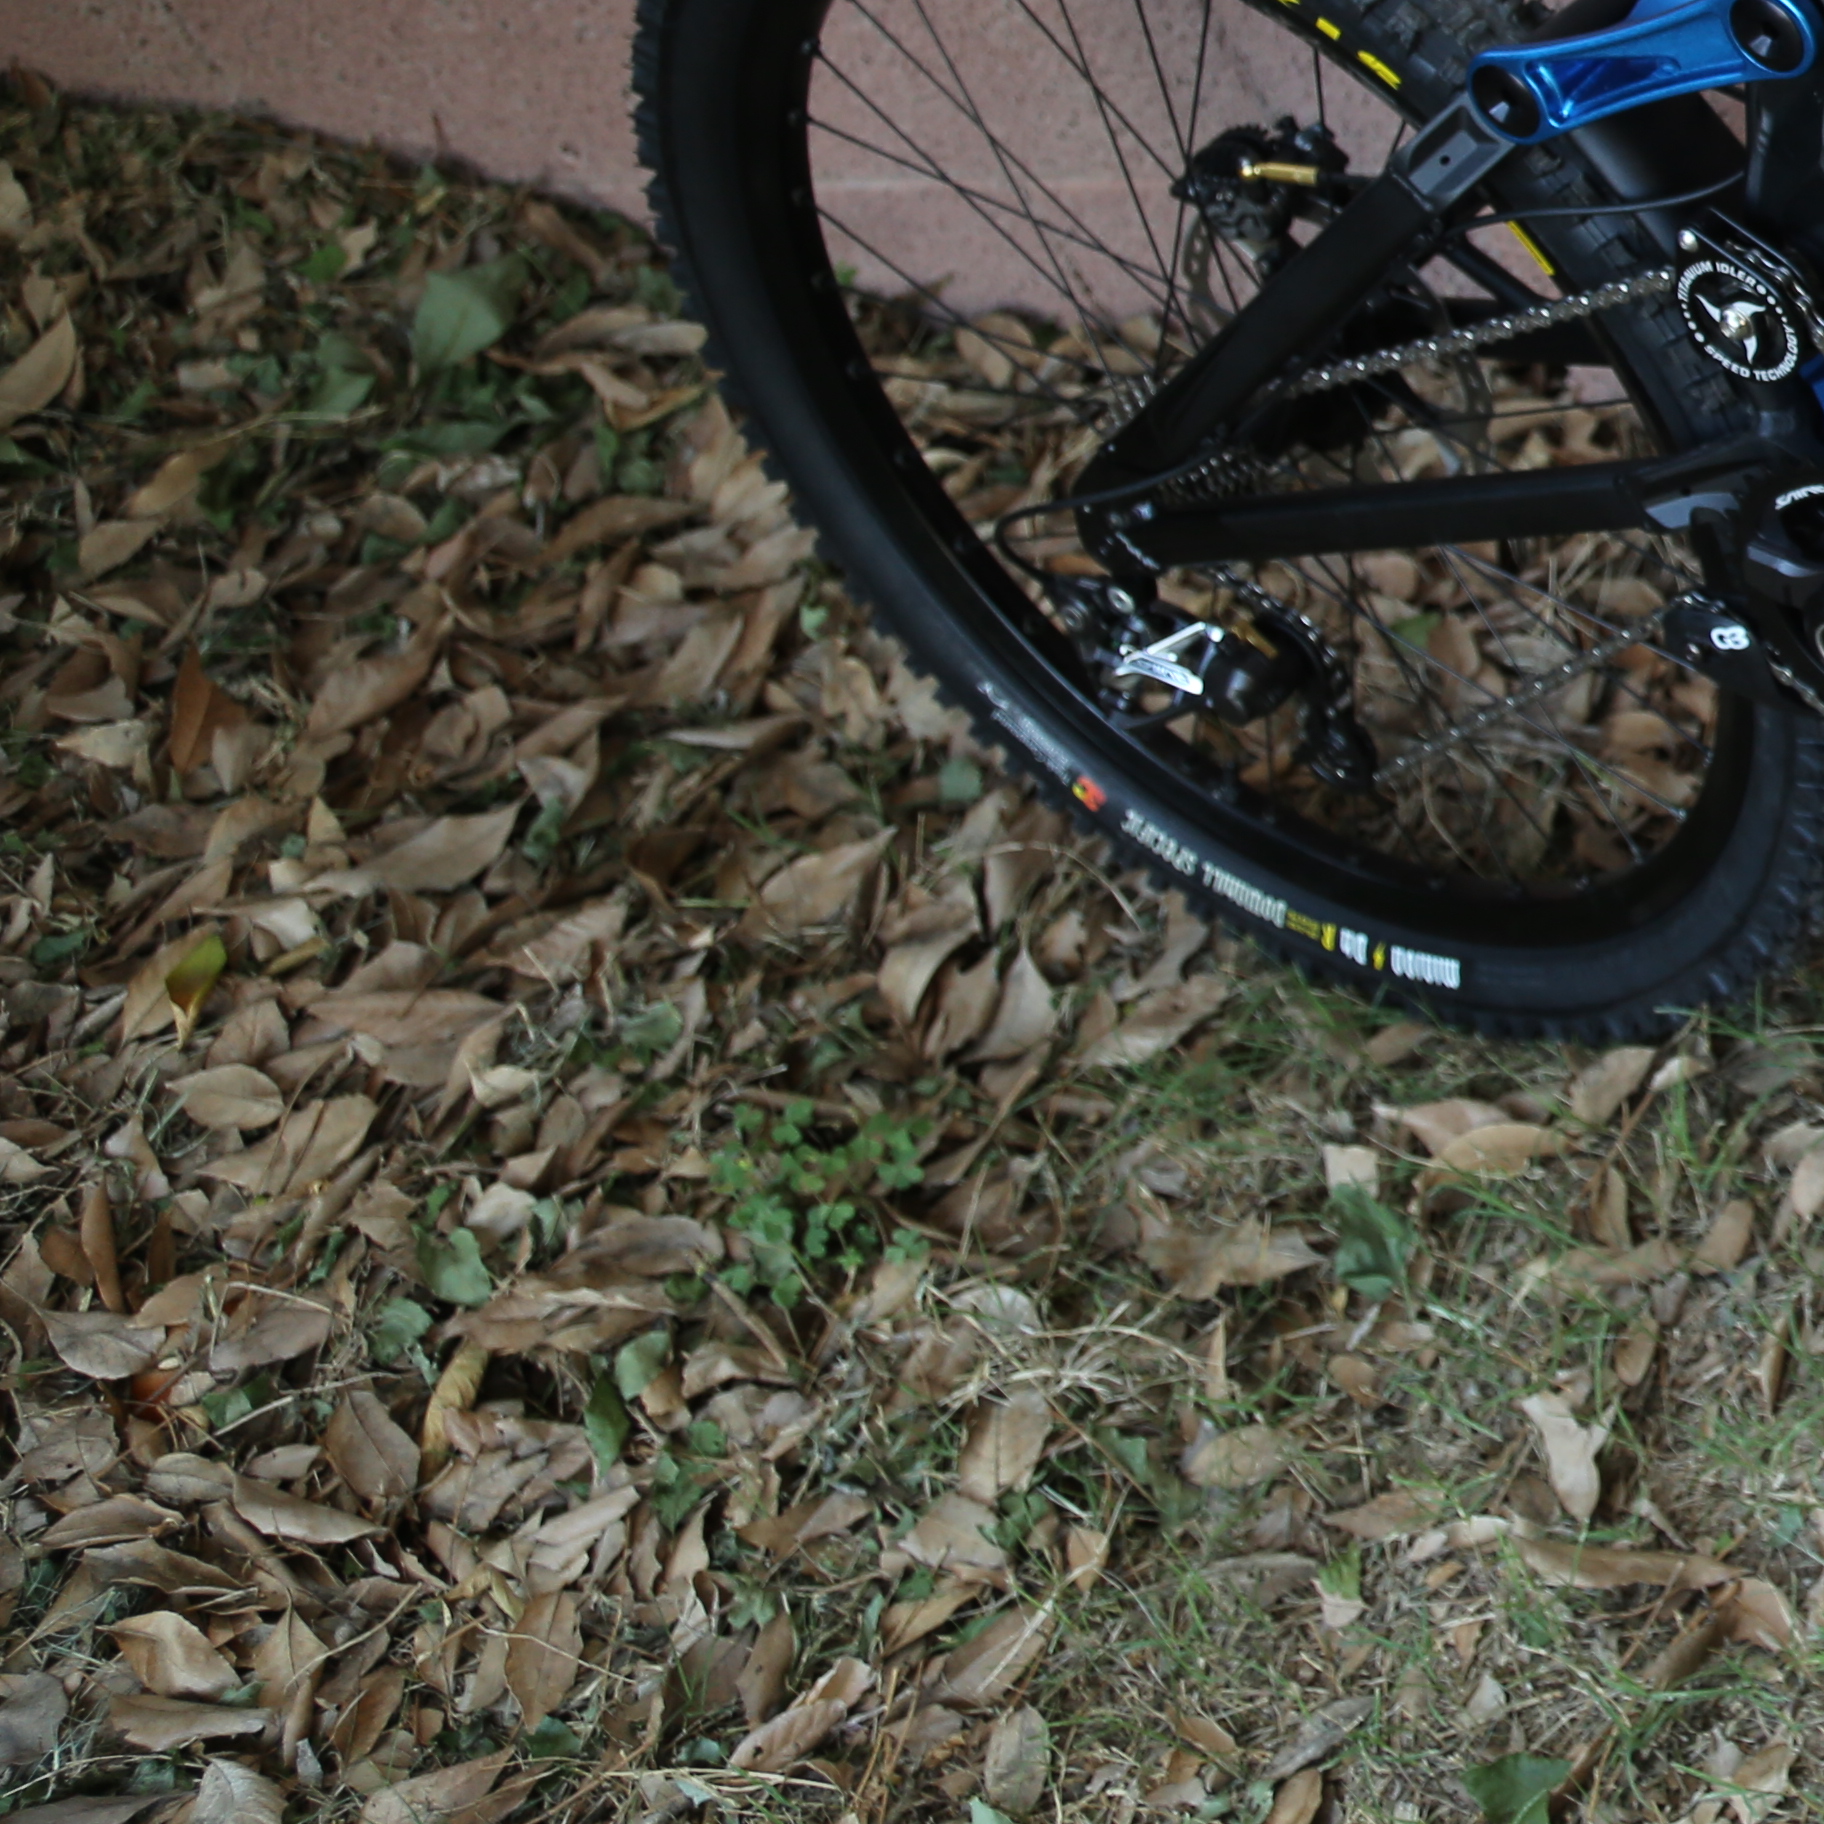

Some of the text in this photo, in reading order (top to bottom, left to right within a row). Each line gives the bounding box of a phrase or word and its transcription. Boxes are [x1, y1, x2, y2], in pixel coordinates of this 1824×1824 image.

[1677, 260, 1757, 303] TITANIUM IDLER
[1703, 323, 1799, 383] SPEED TECHNOLOGY
